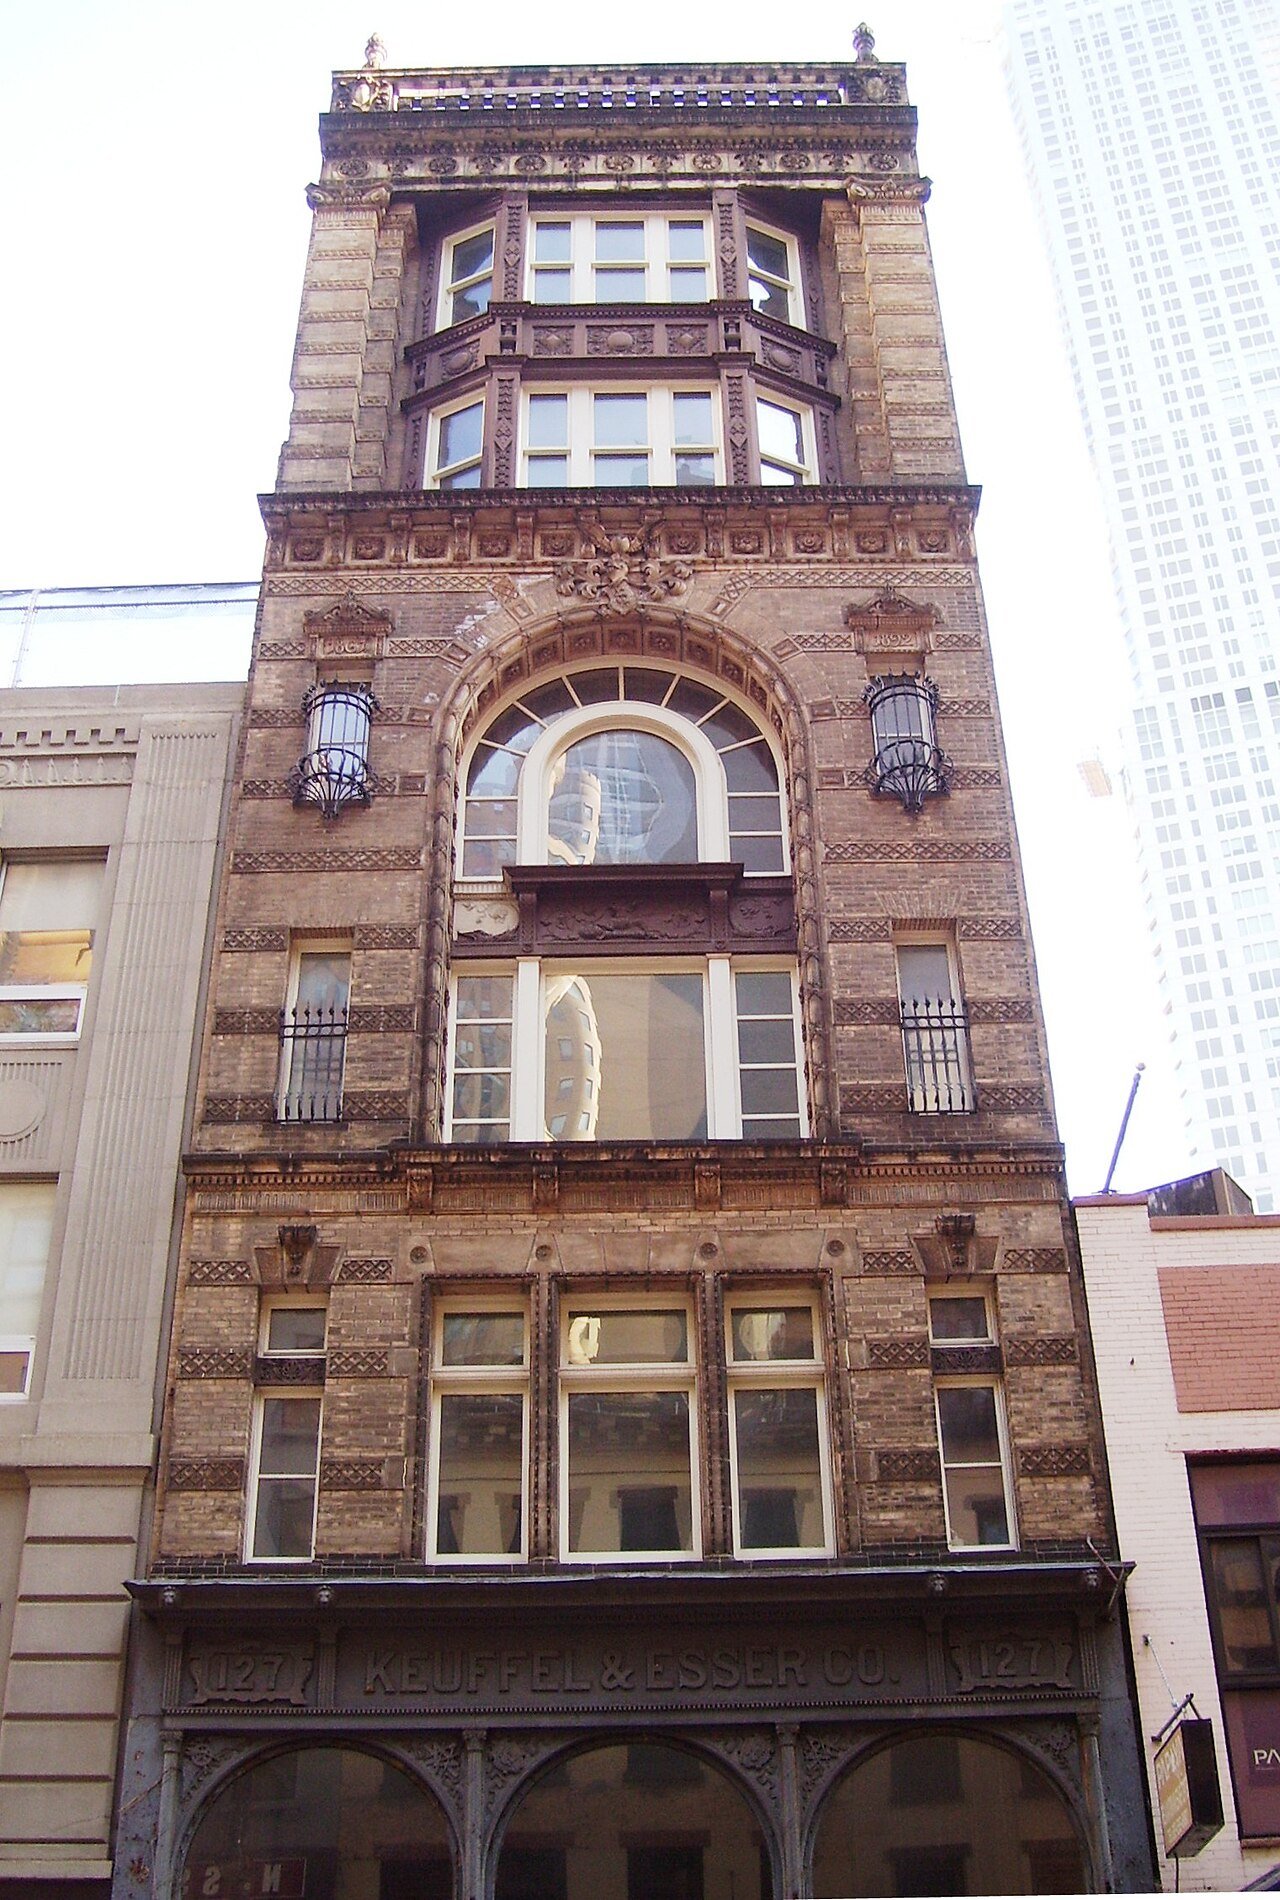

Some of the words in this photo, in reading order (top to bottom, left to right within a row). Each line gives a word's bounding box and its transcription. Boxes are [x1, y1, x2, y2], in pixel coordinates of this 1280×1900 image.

[873, 633, 914, 647] 1892
[216, 1653, 284, 1691] 127
[363, 1650, 591, 1694] KEUFFEL
[600, 1655, 635, 1690] &
[645, 1646, 808, 1690] ESSER
[977, 1639, 1043, 1678] 127
